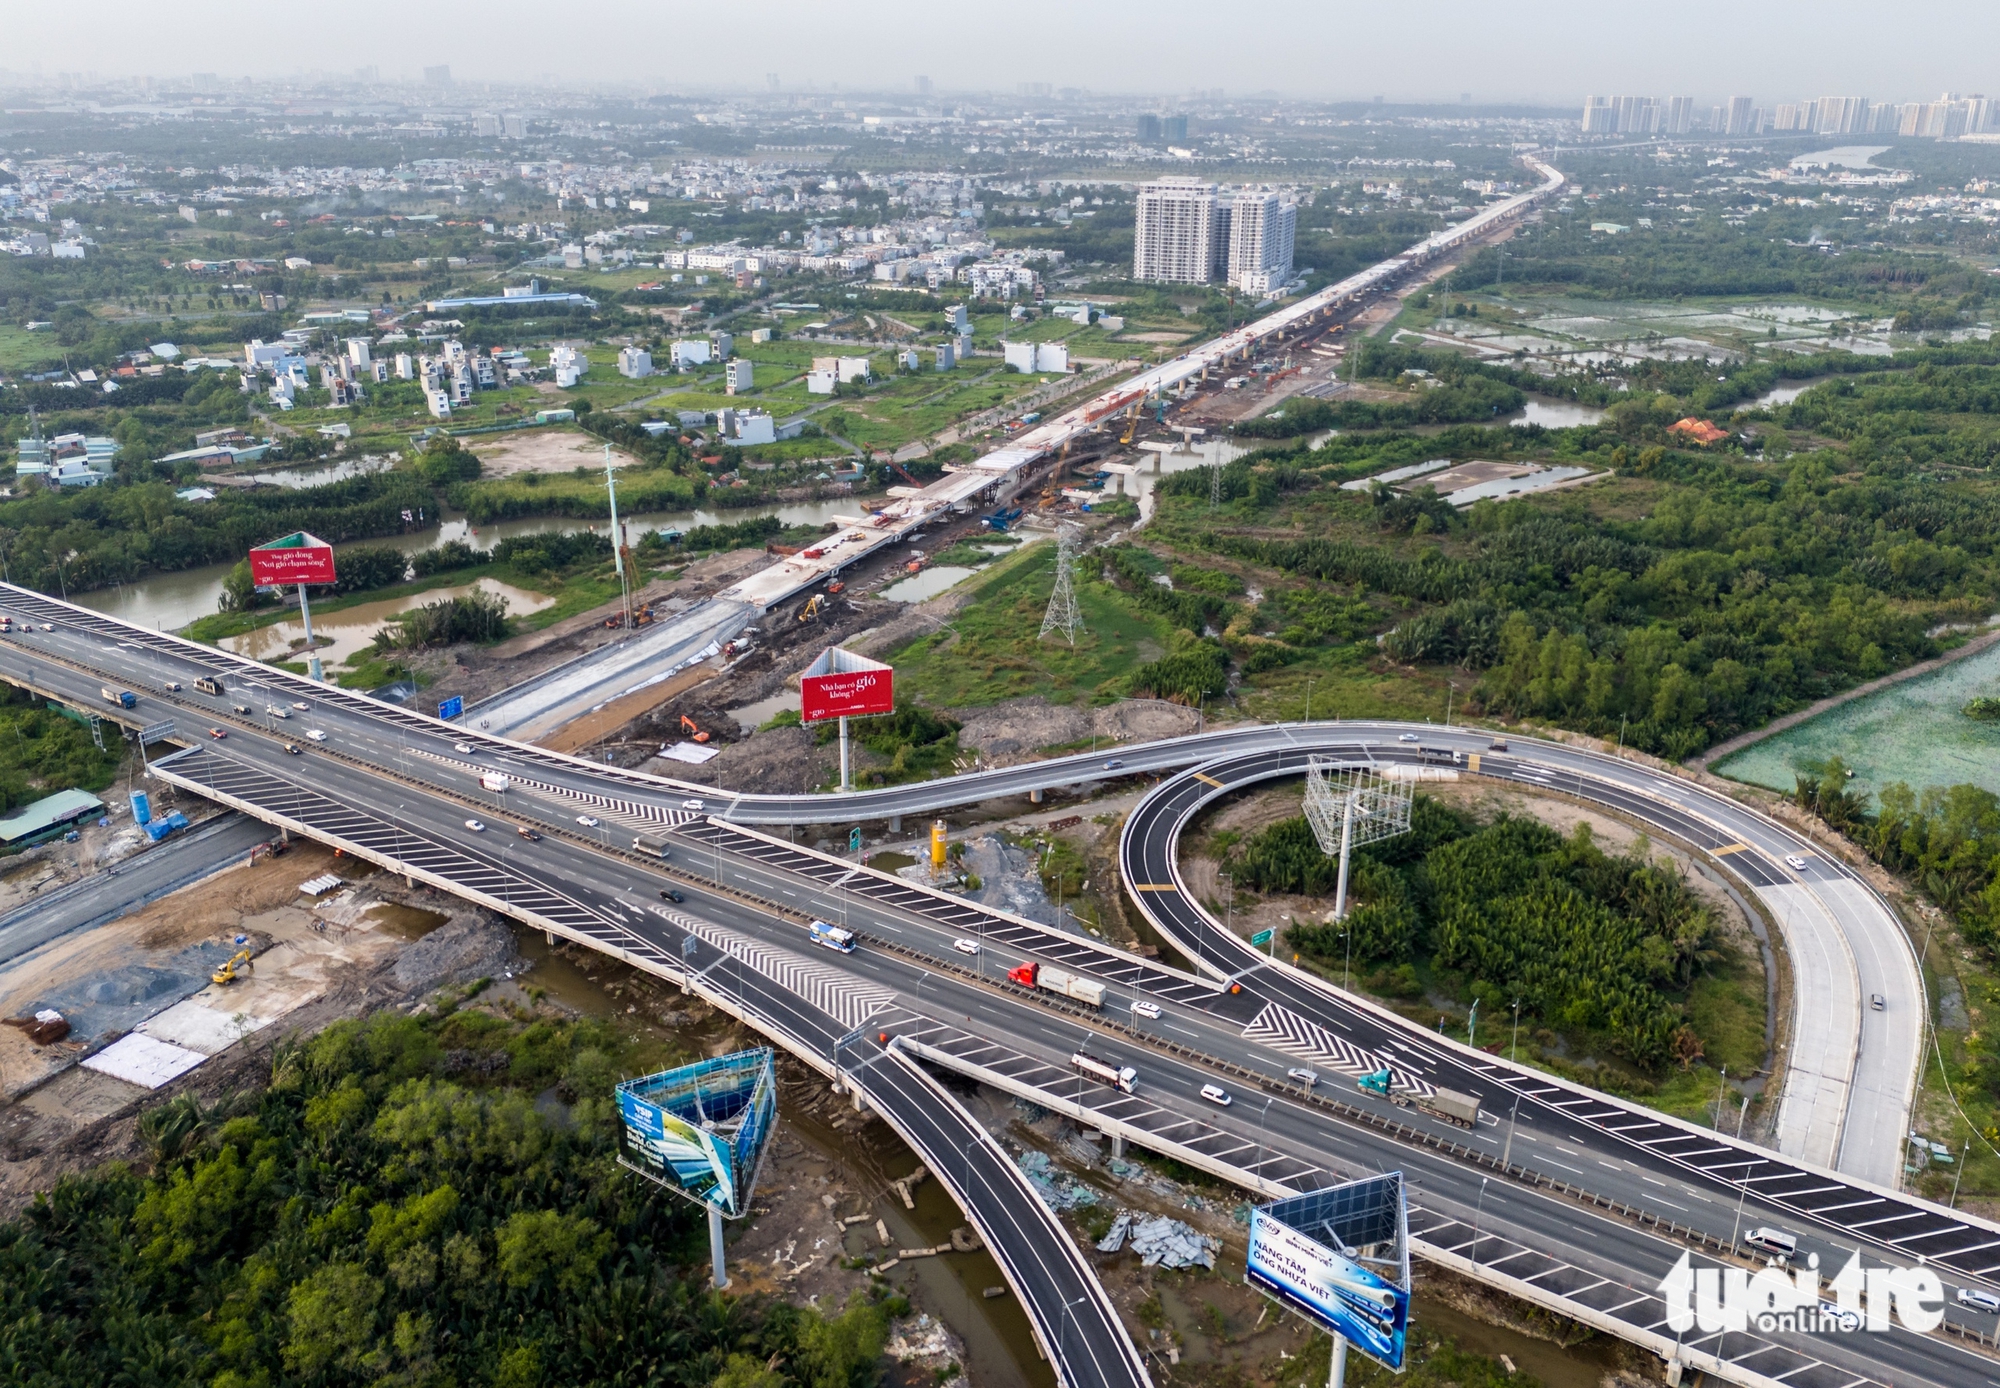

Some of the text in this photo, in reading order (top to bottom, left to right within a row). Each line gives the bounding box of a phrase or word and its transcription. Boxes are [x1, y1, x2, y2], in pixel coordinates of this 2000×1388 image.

[856, 675, 876, 692] gió
[1254, 1240, 1283, 1262] NÂNG
[1277, 1264, 1307, 1288] NHỰA
[1309, 1282, 1330, 1300] VIỆT
